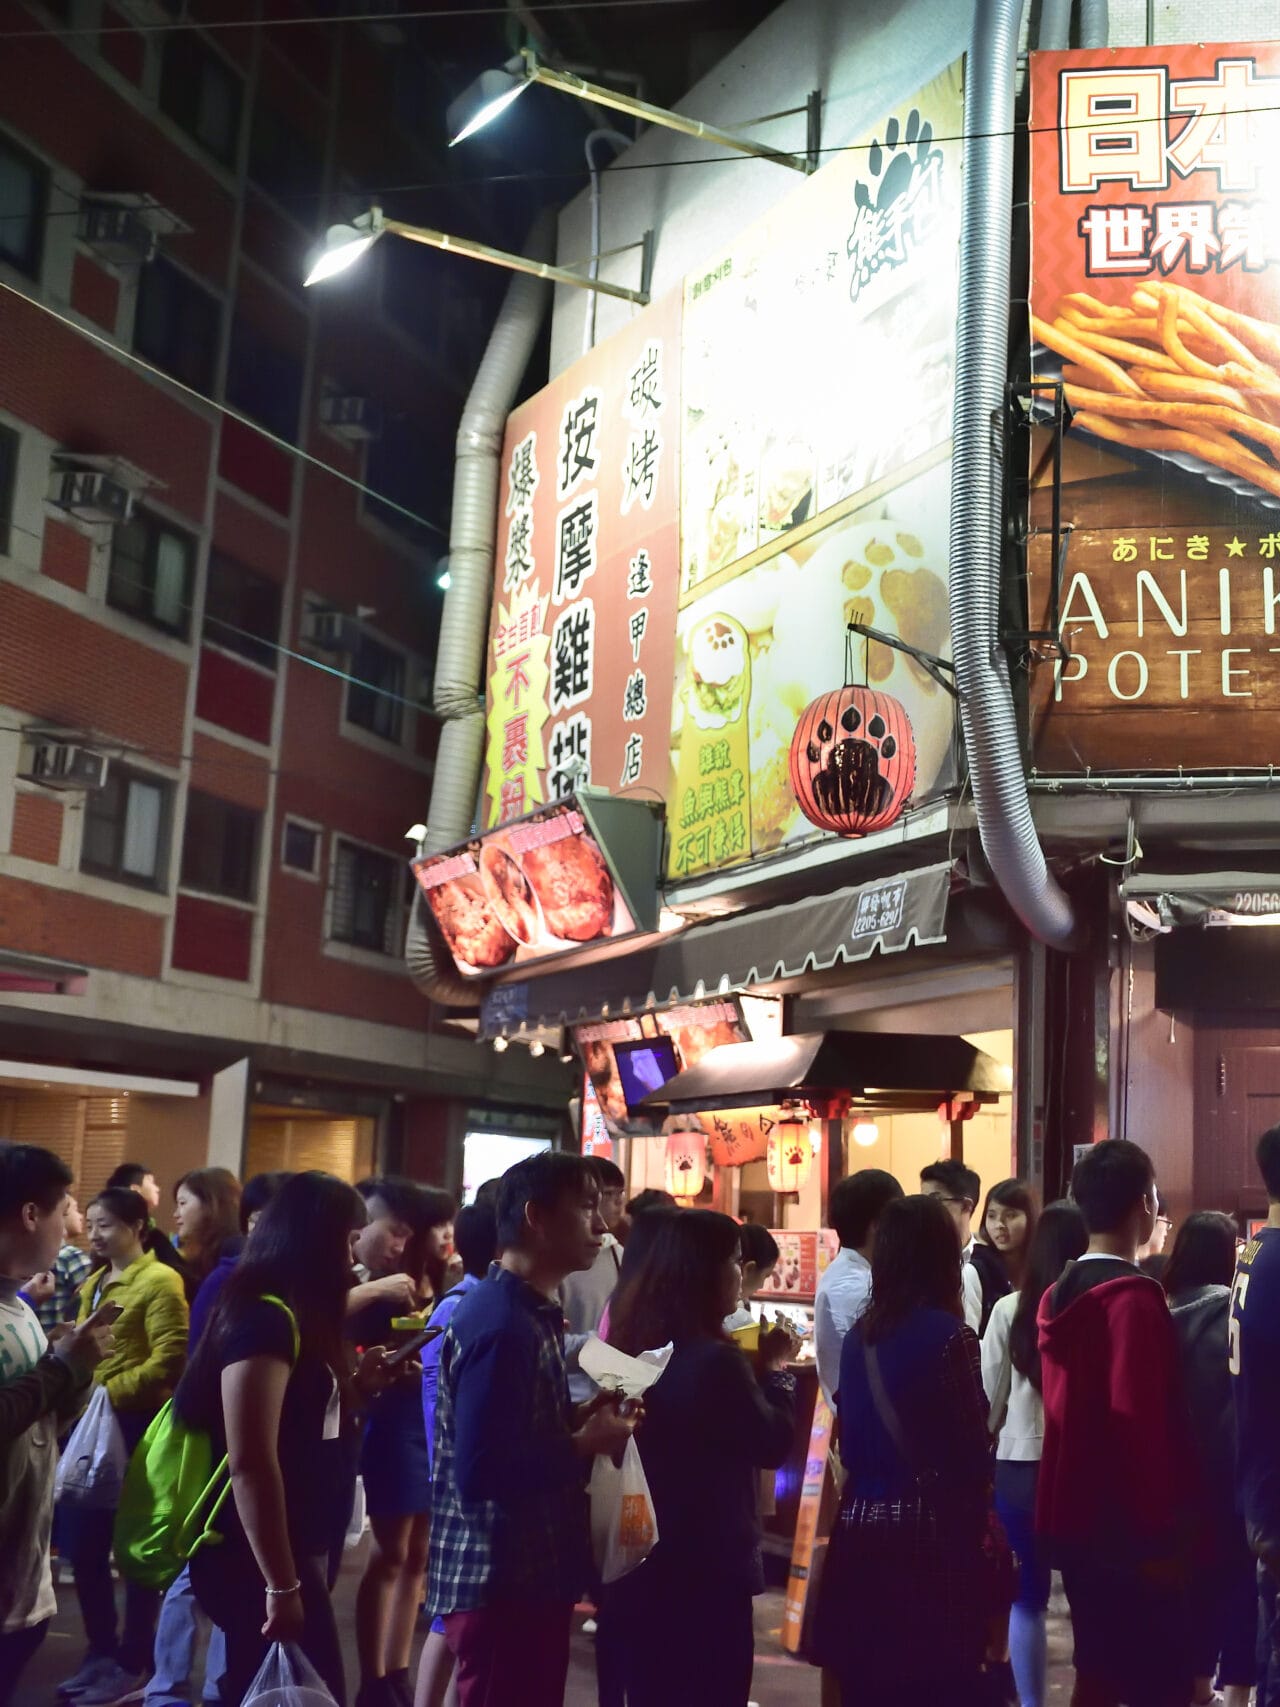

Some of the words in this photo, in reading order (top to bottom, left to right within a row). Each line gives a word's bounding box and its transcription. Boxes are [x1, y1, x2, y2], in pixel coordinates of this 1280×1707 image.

[625, 348, 662, 501] 碳烤
[620, 553, 653, 787] 逢甲總店
